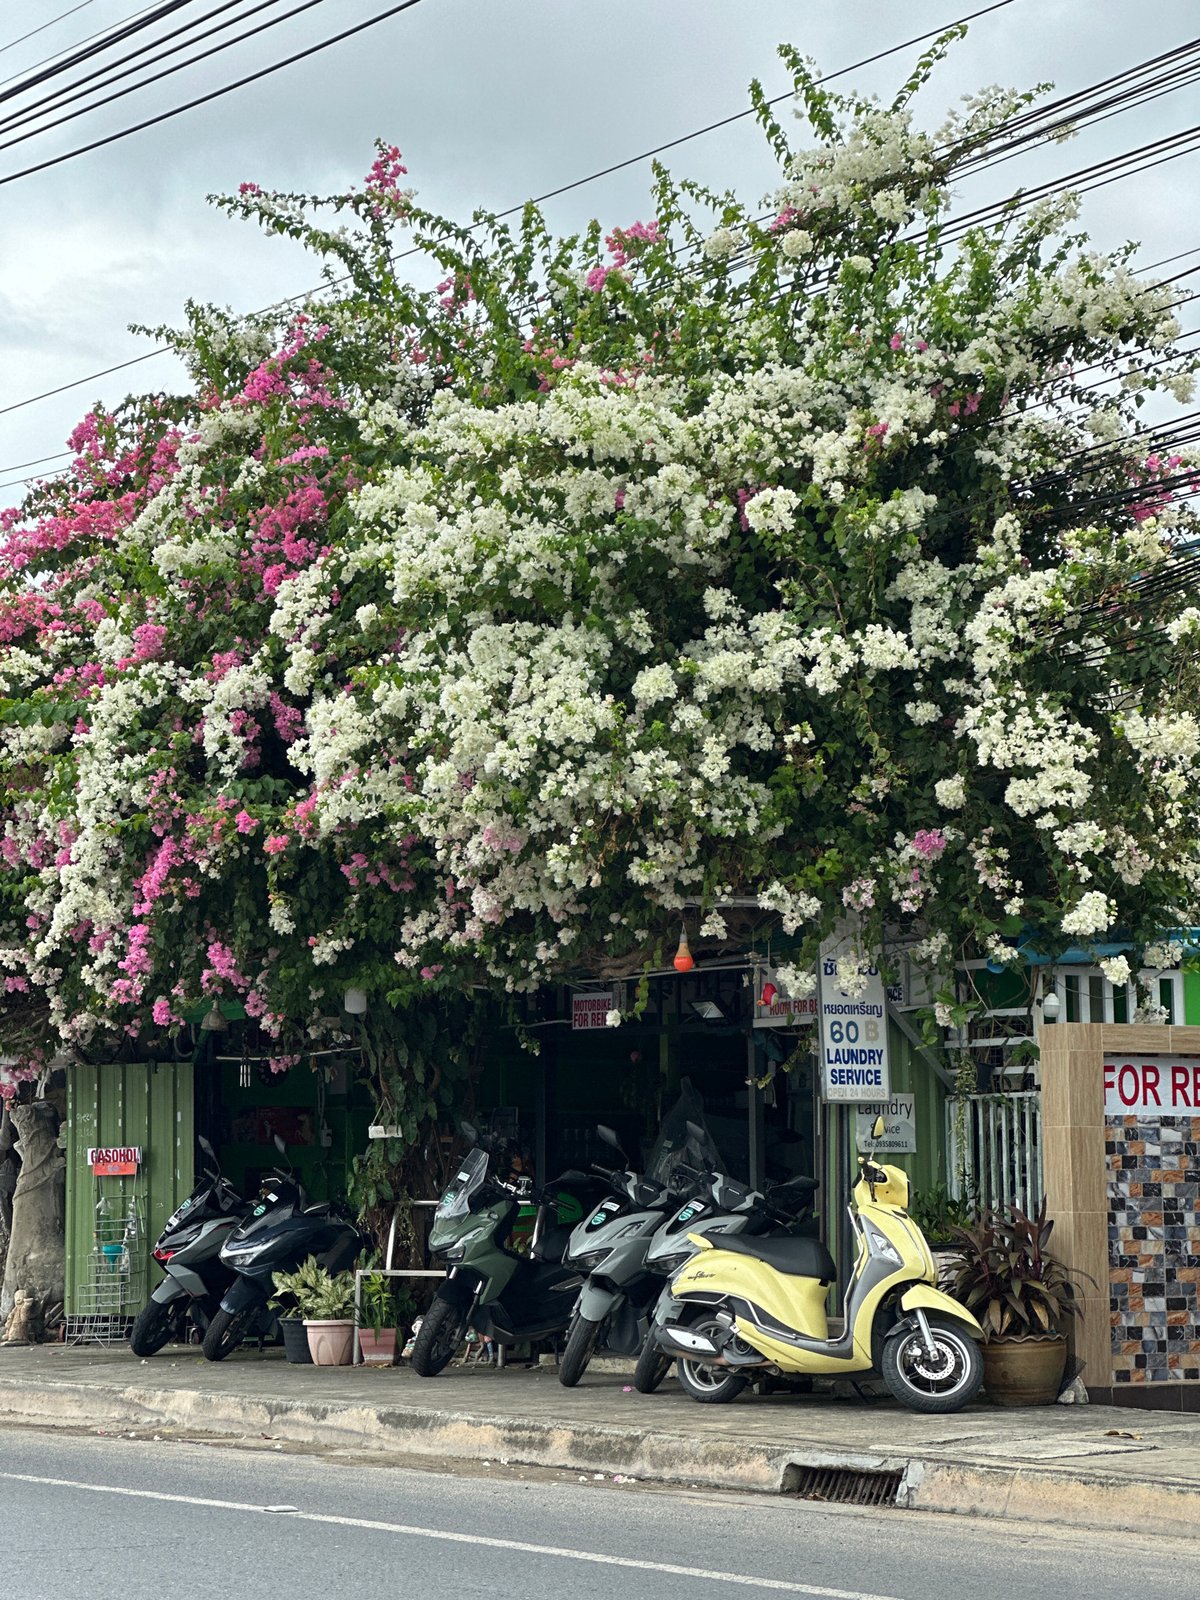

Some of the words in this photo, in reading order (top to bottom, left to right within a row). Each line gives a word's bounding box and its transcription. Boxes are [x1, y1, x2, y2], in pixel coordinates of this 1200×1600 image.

[573, 999, 612, 1011] MOTORBIKE
[793, 1000, 808, 1013] FOR
[823, 1001, 883, 1018] หยอดเหรียญ
[573, 1012, 589, 1027] FOR
[591, 1011, 608, 1027] REN
[830, 1020, 859, 1044] 60
[826, 1048, 884, 1065] LAUNDRY
[830, 1068, 882, 1085] SERVICE
[828, 1087, 847, 1098] OPEN
[850, 1088, 859, 1098] 24
[861, 1088, 886, 1098] HOURS
[1103, 1064, 1162, 1107] FOR
[858, 1098, 913, 1119] Laundry
